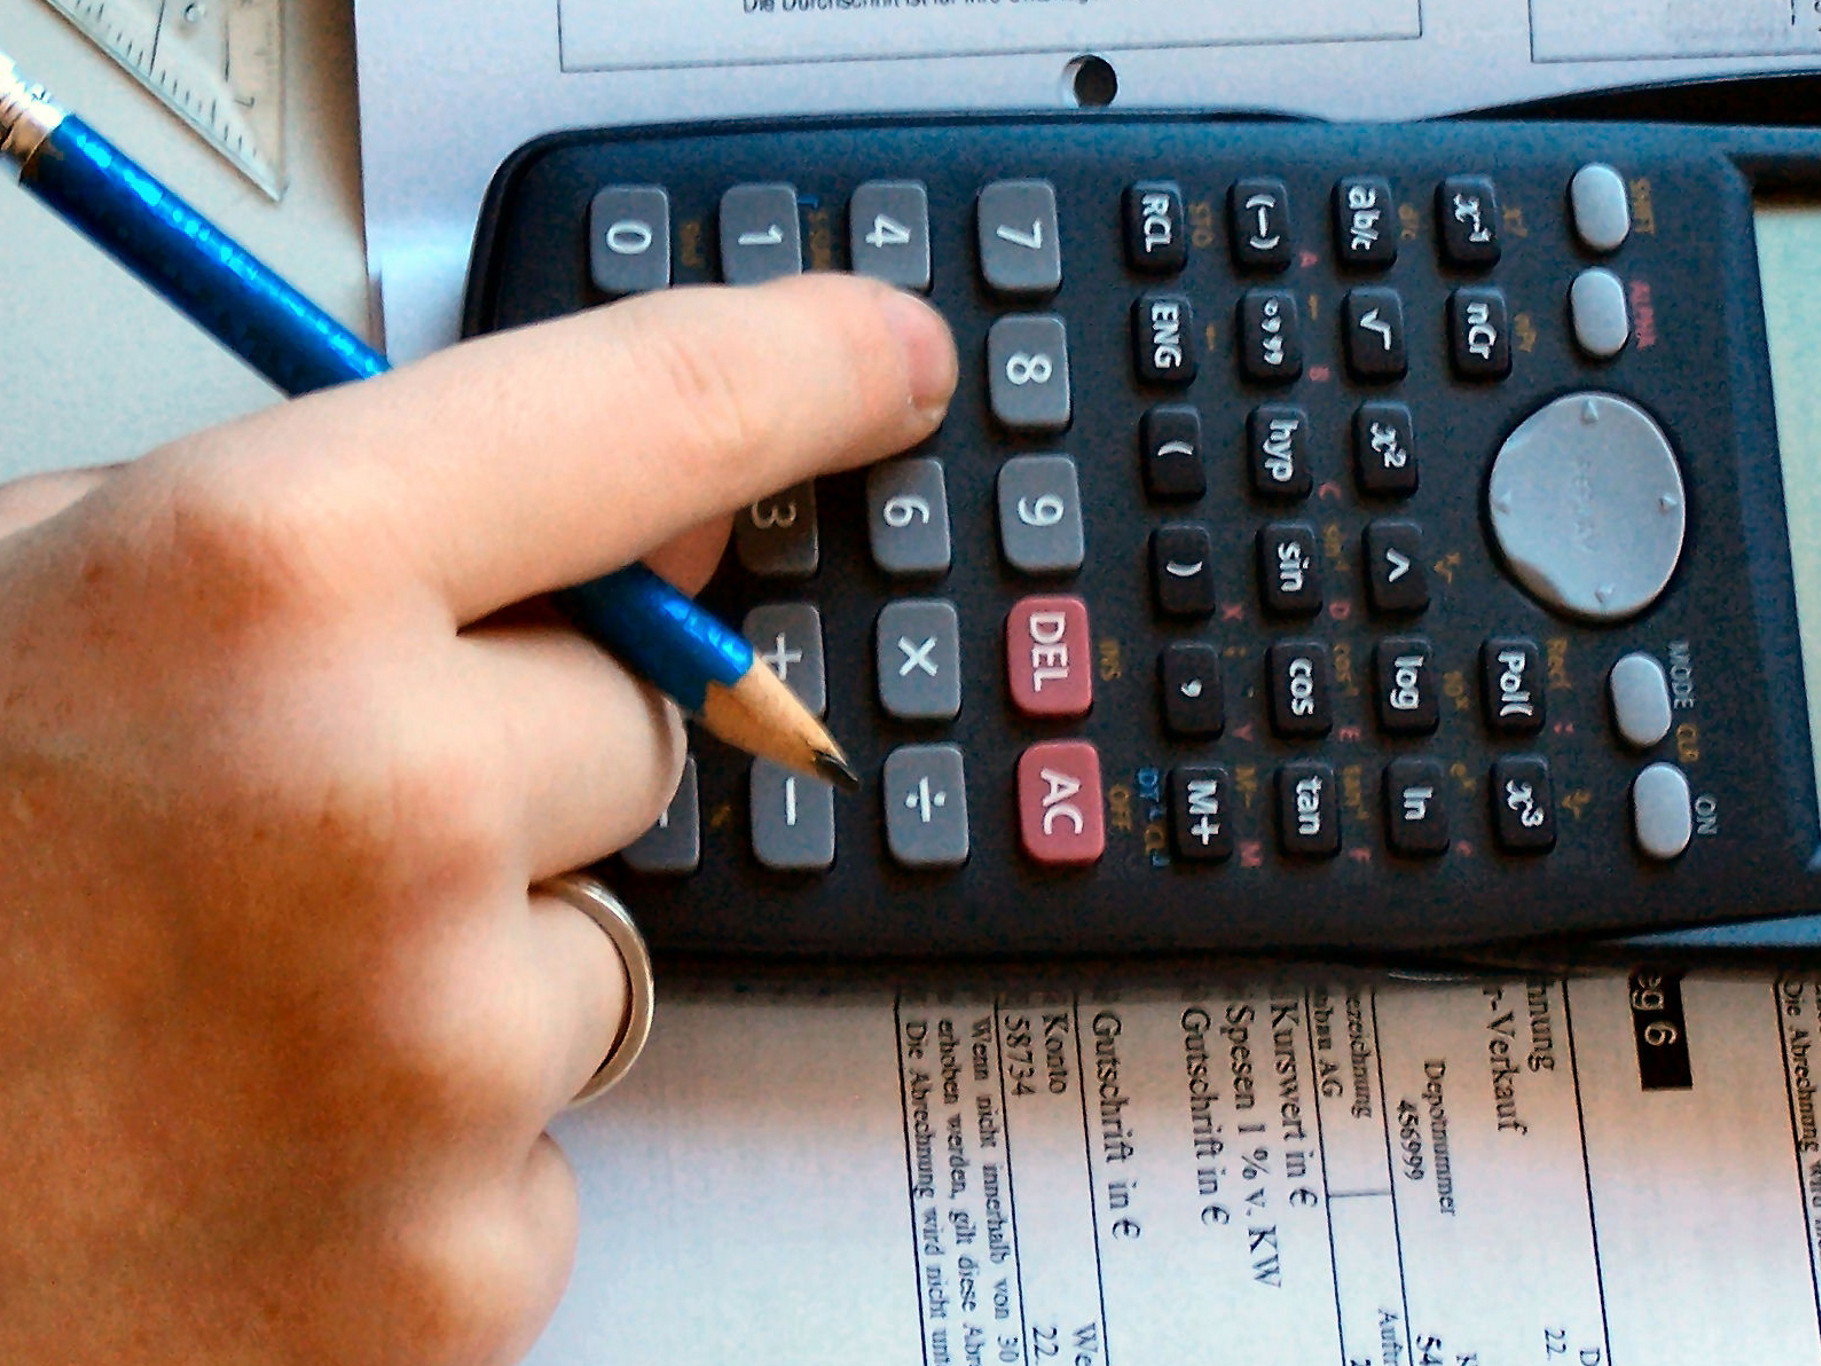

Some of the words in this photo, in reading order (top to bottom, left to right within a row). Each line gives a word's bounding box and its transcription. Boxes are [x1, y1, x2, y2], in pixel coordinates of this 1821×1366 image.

[605, 221, 654, 256] 0
[737, 223, 784, 247] 1
[864, 213, 912, 249] 4
[995, 218, 1044, 250] 7
[1141, 193, 1172, 253] RCL
[1151, 302, 1182, 368] ENG
[1466, 303, 1497, 360] nCr
[1005, 352, 1053, 386] 8
[1263, 419, 1299, 482] hyp
[750, 500, 798, 530] 3
[882, 496, 930, 528] 6
[1017, 493, 1064, 527] 9
[1278, 541, 1310, 592] sin
[1028, 611, 1069, 692] DEL
[1668, 642, 1695, 709] MODE
[1289, 658, 1314, 716] cos
[1390, 656, 1424, 710] log
[1040, 767, 1083, 835] AC
[1187, 778, 1220, 846] M+
[1296, 776, 1323, 835] tan
[1695, 795, 1717, 835] ON
[1782, 978, 1805, 1017] Die
[904, 1020, 929, 1058] Die
[969, 1016, 994, 1082] Wenn
[1003, 1014, 1036, 1098] 58734
[1041, 1012, 1070, 1096] Konto
[1219, 1005, 1259, 1110] Spesen
[1643, 1021, 1678, 1047] 6
[937, 1019, 963, 1106] erhoben
[1091, 1010, 1136, 1164] Gutschrift
[1180, 1007, 1225, 1161] Gutschrift
[1269, 1001, 1305, 1142] Kurswert
[1319, 1058, 1344, 1098] AG
[1787, 1026, 1821, 1152] Abrechnung
[908, 1071, 939, 1199] Abrechnung
[973, 1095, 1000, 1149] nicht
[1396, 1099, 1425, 1182] 456999
[1421, 1060, 1458, 1218] Depotnummer
[1195, 1168, 1228, 1197] in
[1240, 1147, 1271, 1181] %
[1284, 1150, 1315, 1179] in
[980, 1163, 1011, 1266] innerhalb
[1106, 1180, 1139, 1211] in
[1199, 1206, 1231, 1227] €
[1288, 1188, 1318, 1208] €
[922, 1207, 946, 1257] wird
[948, 1210, 977, 1245] gilt
[1110, 1218, 1142, 1241] €
[1247, 1225, 1283, 1289] KW
[925, 1266, 952, 1321] nicht
[956, 1256, 983, 1313] diese
[992, 1278, 1011, 1321] von
[997, 1334, 1020, 1363] 30
